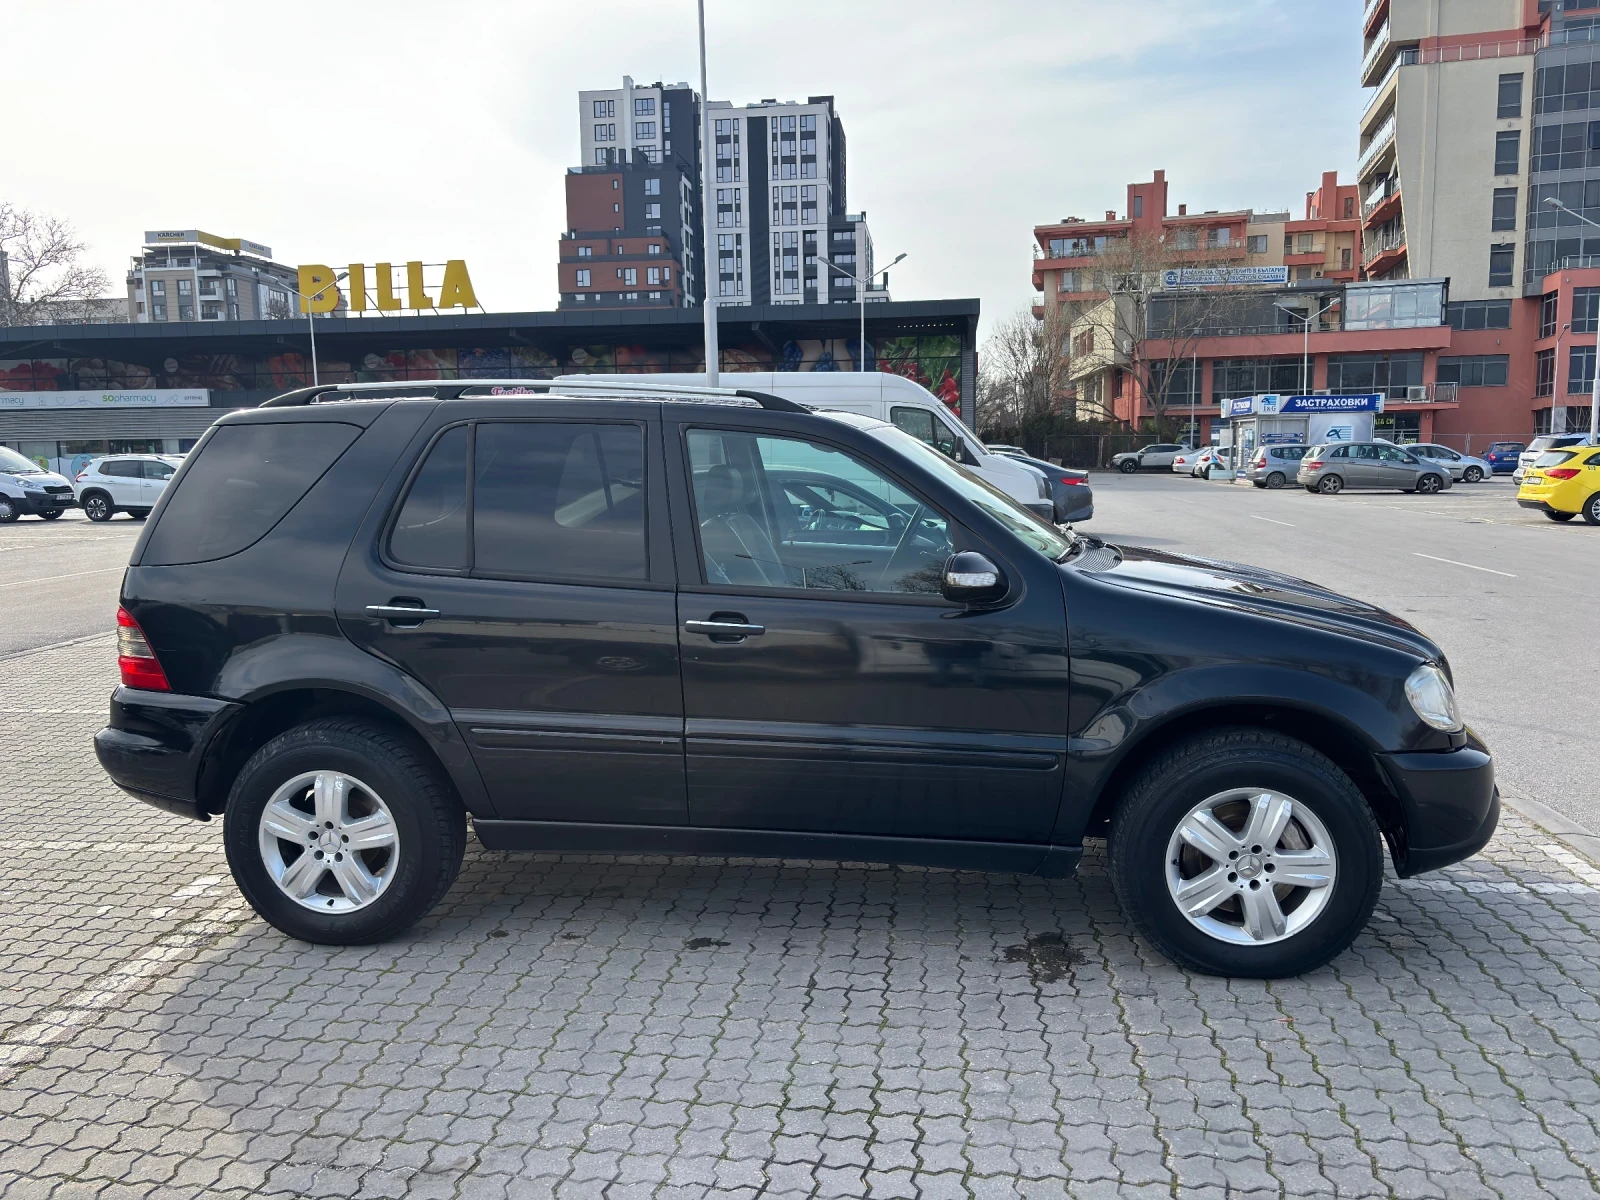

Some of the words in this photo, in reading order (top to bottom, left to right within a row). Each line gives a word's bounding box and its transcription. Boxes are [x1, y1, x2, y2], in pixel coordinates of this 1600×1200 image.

[297, 260, 478, 313] BILLA
[102, 394, 157, 404] sopharmacy
[1295, 397, 1368, 406] ЗАСТРАХОВКИ
